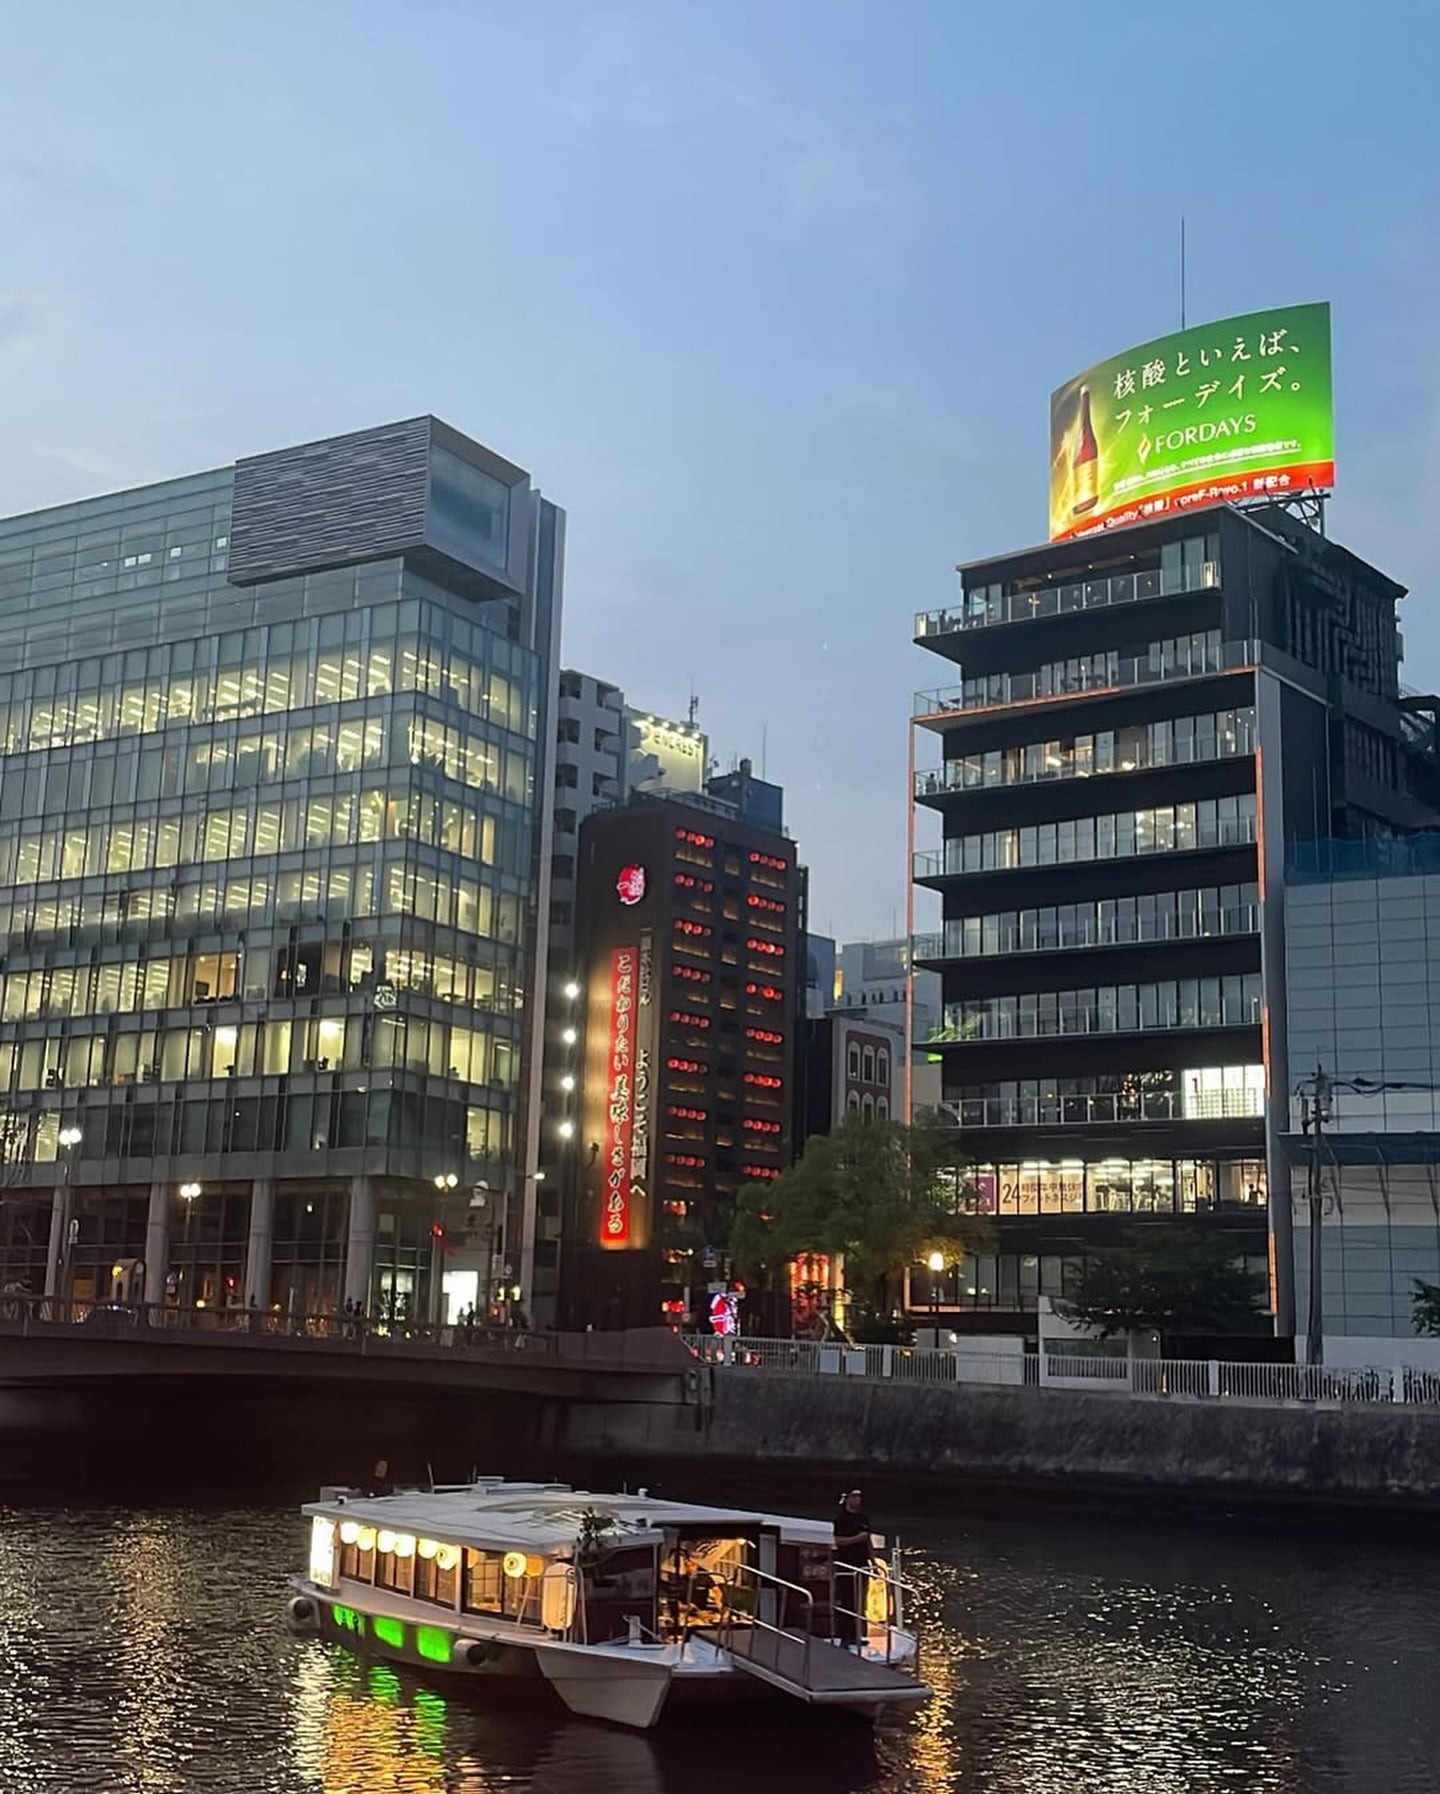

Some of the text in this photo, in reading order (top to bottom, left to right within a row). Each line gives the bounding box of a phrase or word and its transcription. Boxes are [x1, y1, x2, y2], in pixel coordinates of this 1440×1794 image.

[1113, 328, 1301, 400] 核酸といえば、
[1115, 366, 1302, 434] フォーデイズ。
[1155, 414, 1257, 454] FORDAYS
